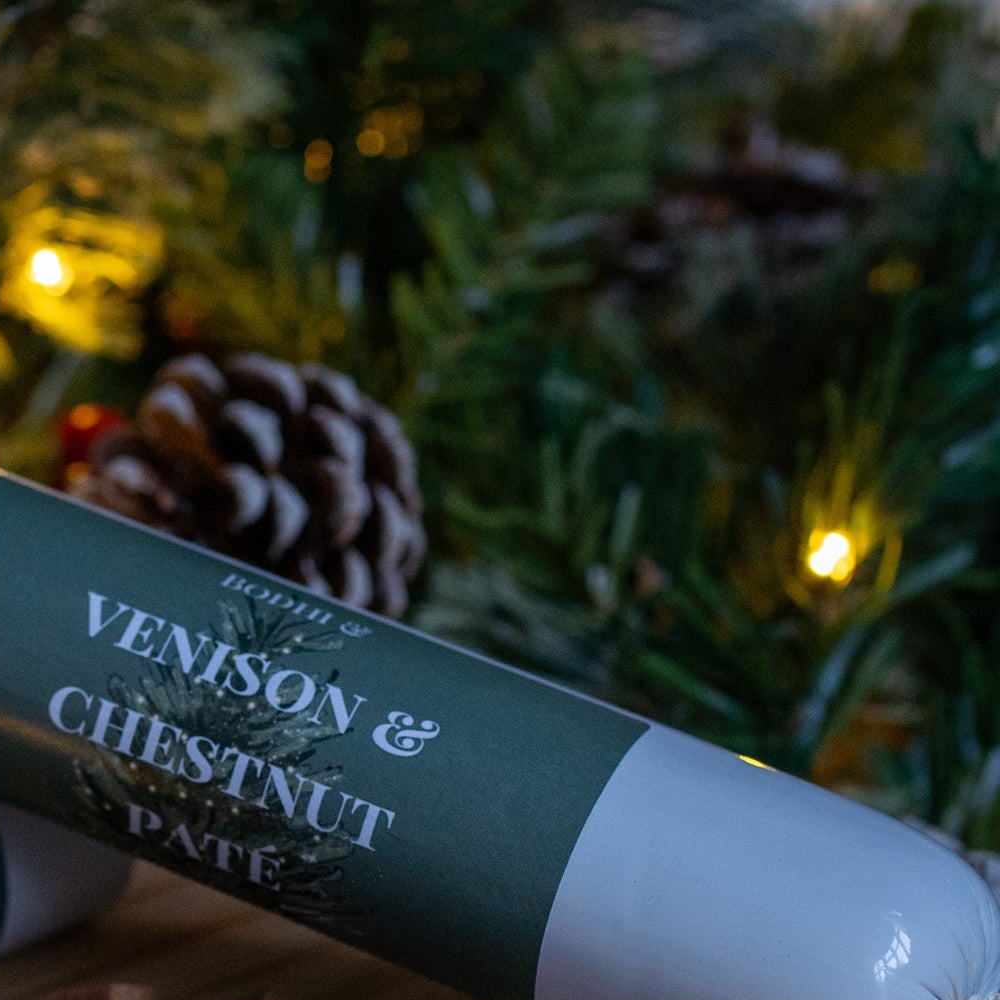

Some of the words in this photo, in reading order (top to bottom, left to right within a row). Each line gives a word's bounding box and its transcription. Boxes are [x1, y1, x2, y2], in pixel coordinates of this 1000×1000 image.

[221, 573, 332, 625] BODHI
[88, 591, 366, 734] VENISON
[372, 711, 440, 757] &
[48, 686, 395, 851] CHESTNUT
[128, 803, 281, 891] PATÉ
